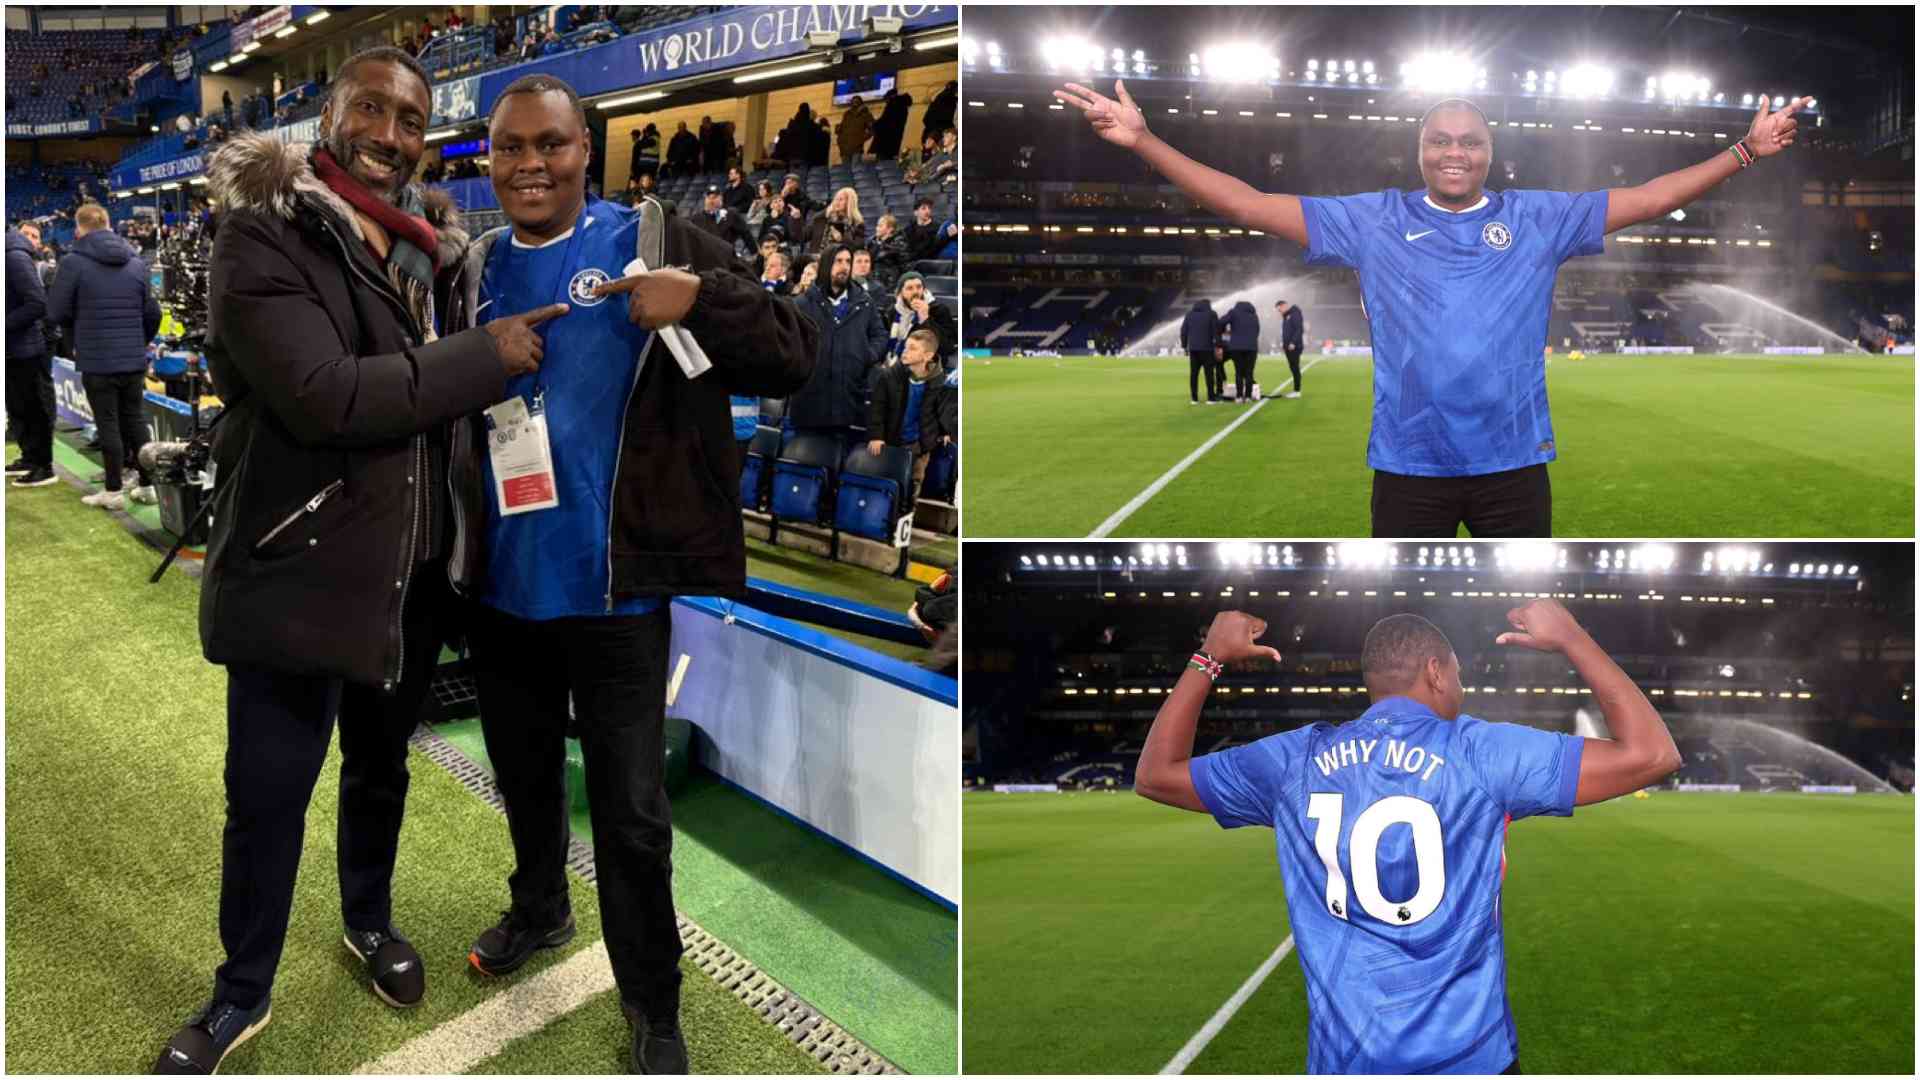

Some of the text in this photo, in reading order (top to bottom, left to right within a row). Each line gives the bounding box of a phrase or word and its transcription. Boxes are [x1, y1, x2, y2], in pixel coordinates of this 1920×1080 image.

[752, 5, 943, 50] CHAM
[139, 167, 152, 183] THE
[901, 520, 910, 542] C
[1314, 740, 1444, 781] WHY NOT
[1306, 792, 1446, 927] 10
